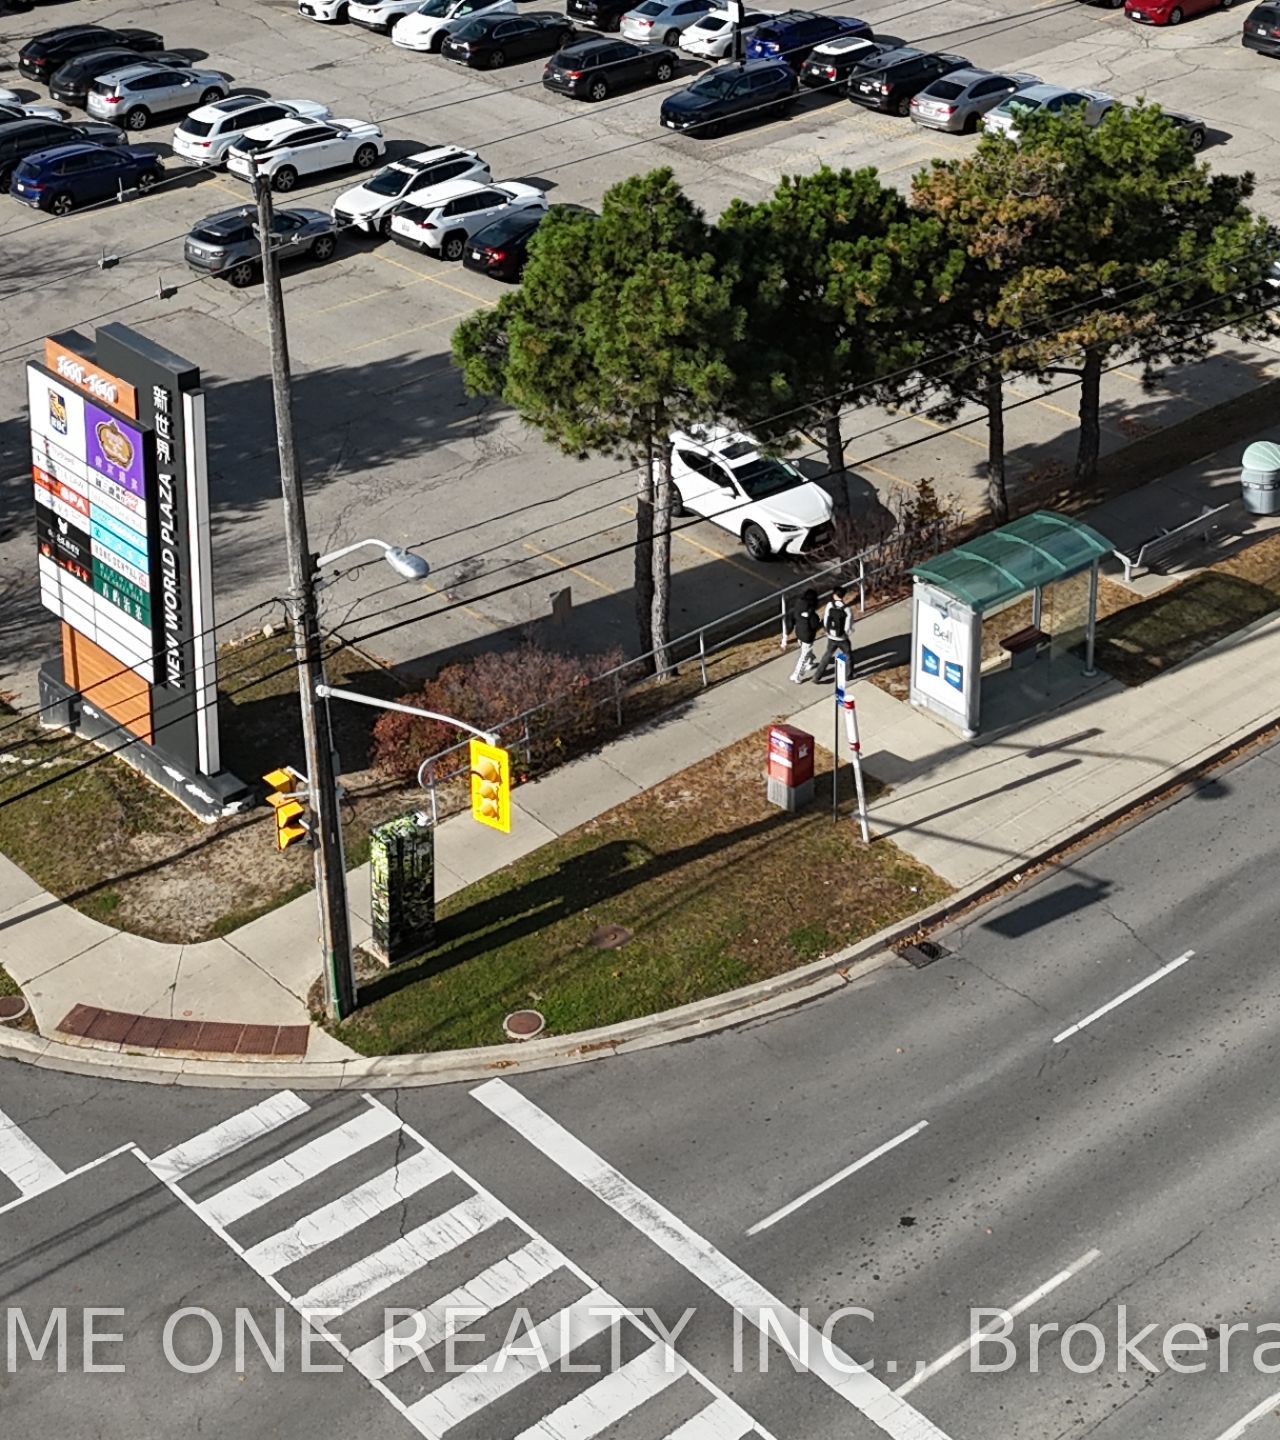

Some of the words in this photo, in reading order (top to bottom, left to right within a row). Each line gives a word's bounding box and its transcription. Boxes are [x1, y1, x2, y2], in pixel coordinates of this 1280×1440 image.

[153, 385, 171, 465] 新世界
[159, 473, 174, 546] PLAZA
[162, 548, 178, 630] WORLD
[166, 632, 181, 688] NEW
[933, 622, 953, 644] Bell
